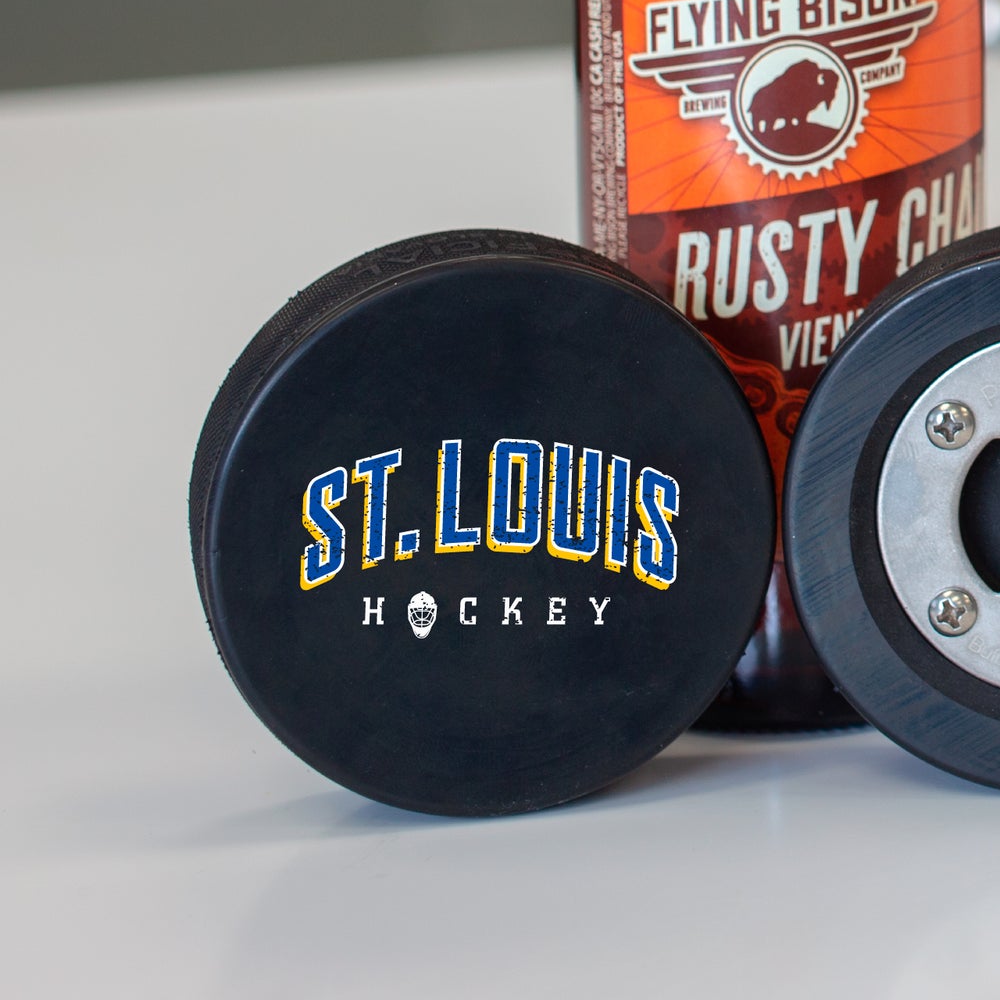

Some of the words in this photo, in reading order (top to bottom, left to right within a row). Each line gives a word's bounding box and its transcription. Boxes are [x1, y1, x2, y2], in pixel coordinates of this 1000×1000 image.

[588, 20, 603, 63] CASH
[611, 30, 623, 58] USA
[588, 63, 603, 86] CA
[612, 59, 624, 84] THE
[860, 62, 902, 84] COMPANY
[613, 85, 625, 105] OF
[683, 95, 727, 114] BREWING
[614, 105, 626, 167] PRODUCT
[673, 198, 879, 322] RUSTY
[896, 148, 986, 278] CHAI
[779, 308, 865, 372] VIEN
[434, 437, 681, 591] LOUIS
